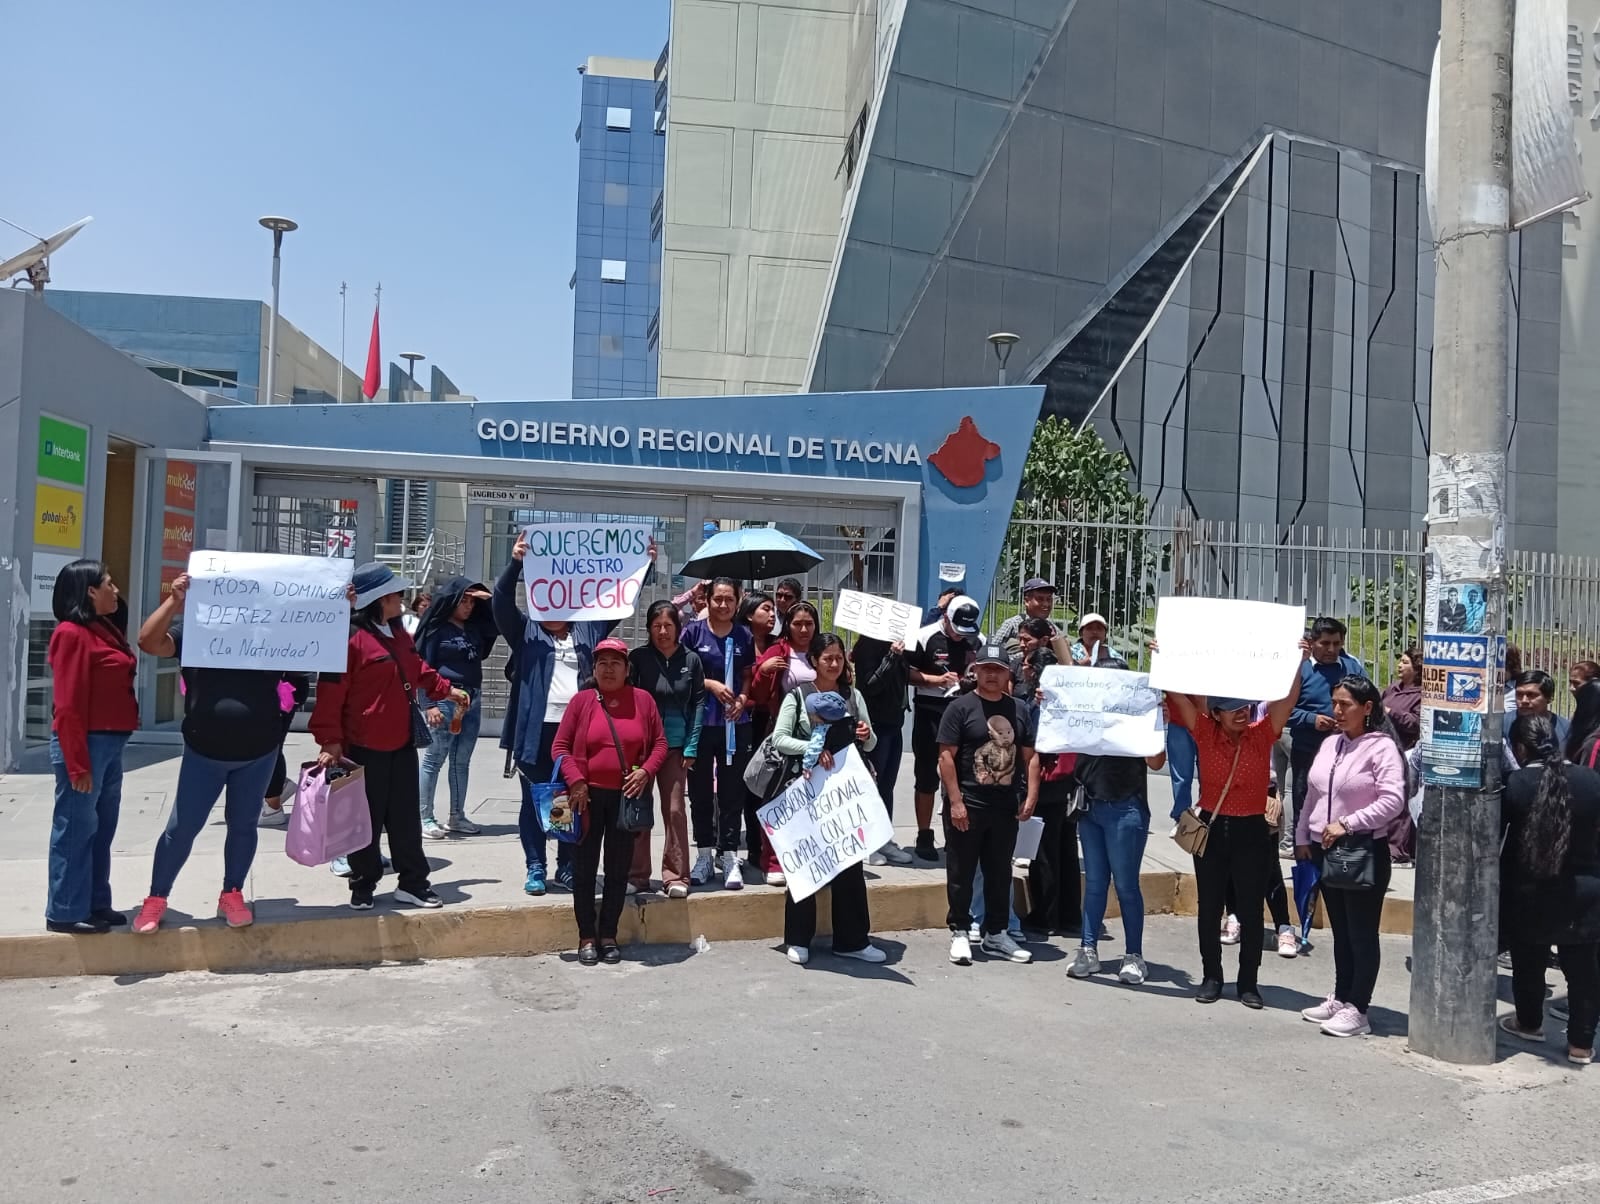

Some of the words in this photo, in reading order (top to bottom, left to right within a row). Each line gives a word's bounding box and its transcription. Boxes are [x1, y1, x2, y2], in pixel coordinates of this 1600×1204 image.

[52, 443, 81, 462] Interbank
[477, 417, 630, 448] GOBIERNO
[637, 427, 781, 457] REGIONAL
[787, 435, 824, 460] DE
[831, 438, 922, 466] TACNA
[473, 490, 508, 499] INGRESO
[519, 492, 530, 500] 01
[530, 528, 647, 557] QUEREMOS
[551, 557, 624, 576] NUESTRO
[273, 581, 346, 600] DOMINGA
[530, 578, 641, 612] COLEGIO
[200, 604, 272, 625] PEREZ
[806, 775, 866, 825] REGIONAL
[820, 812, 846, 844] CON
[848, 803, 868, 829] LA
